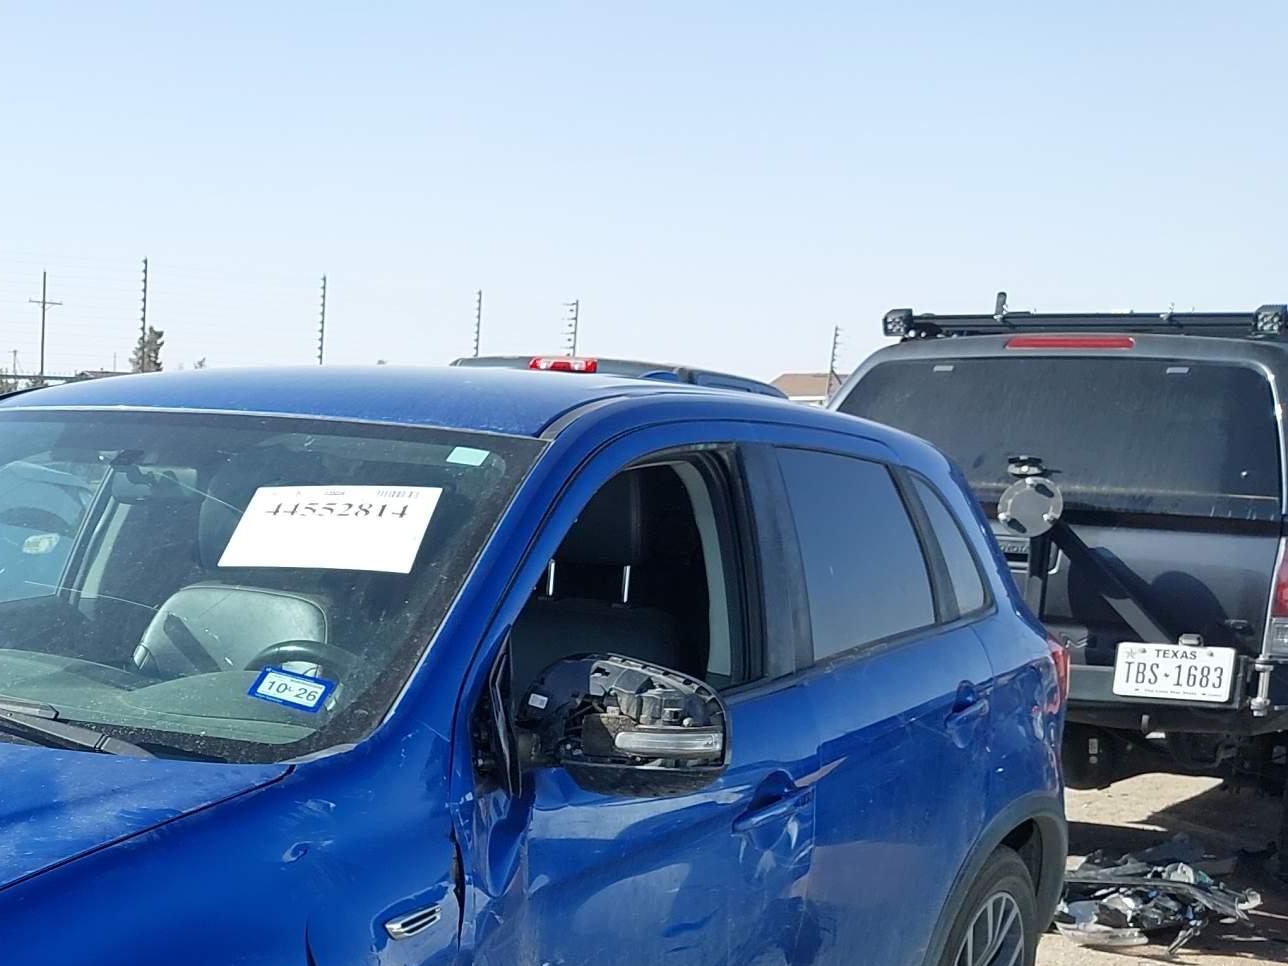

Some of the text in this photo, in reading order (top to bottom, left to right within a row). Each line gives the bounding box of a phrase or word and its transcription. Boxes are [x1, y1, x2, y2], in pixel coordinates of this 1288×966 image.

[265, 502, 409, 519] 44552814
[999, 543, 1029, 554] OYOTA
[1154, 648, 1198, 661] TEXAS
